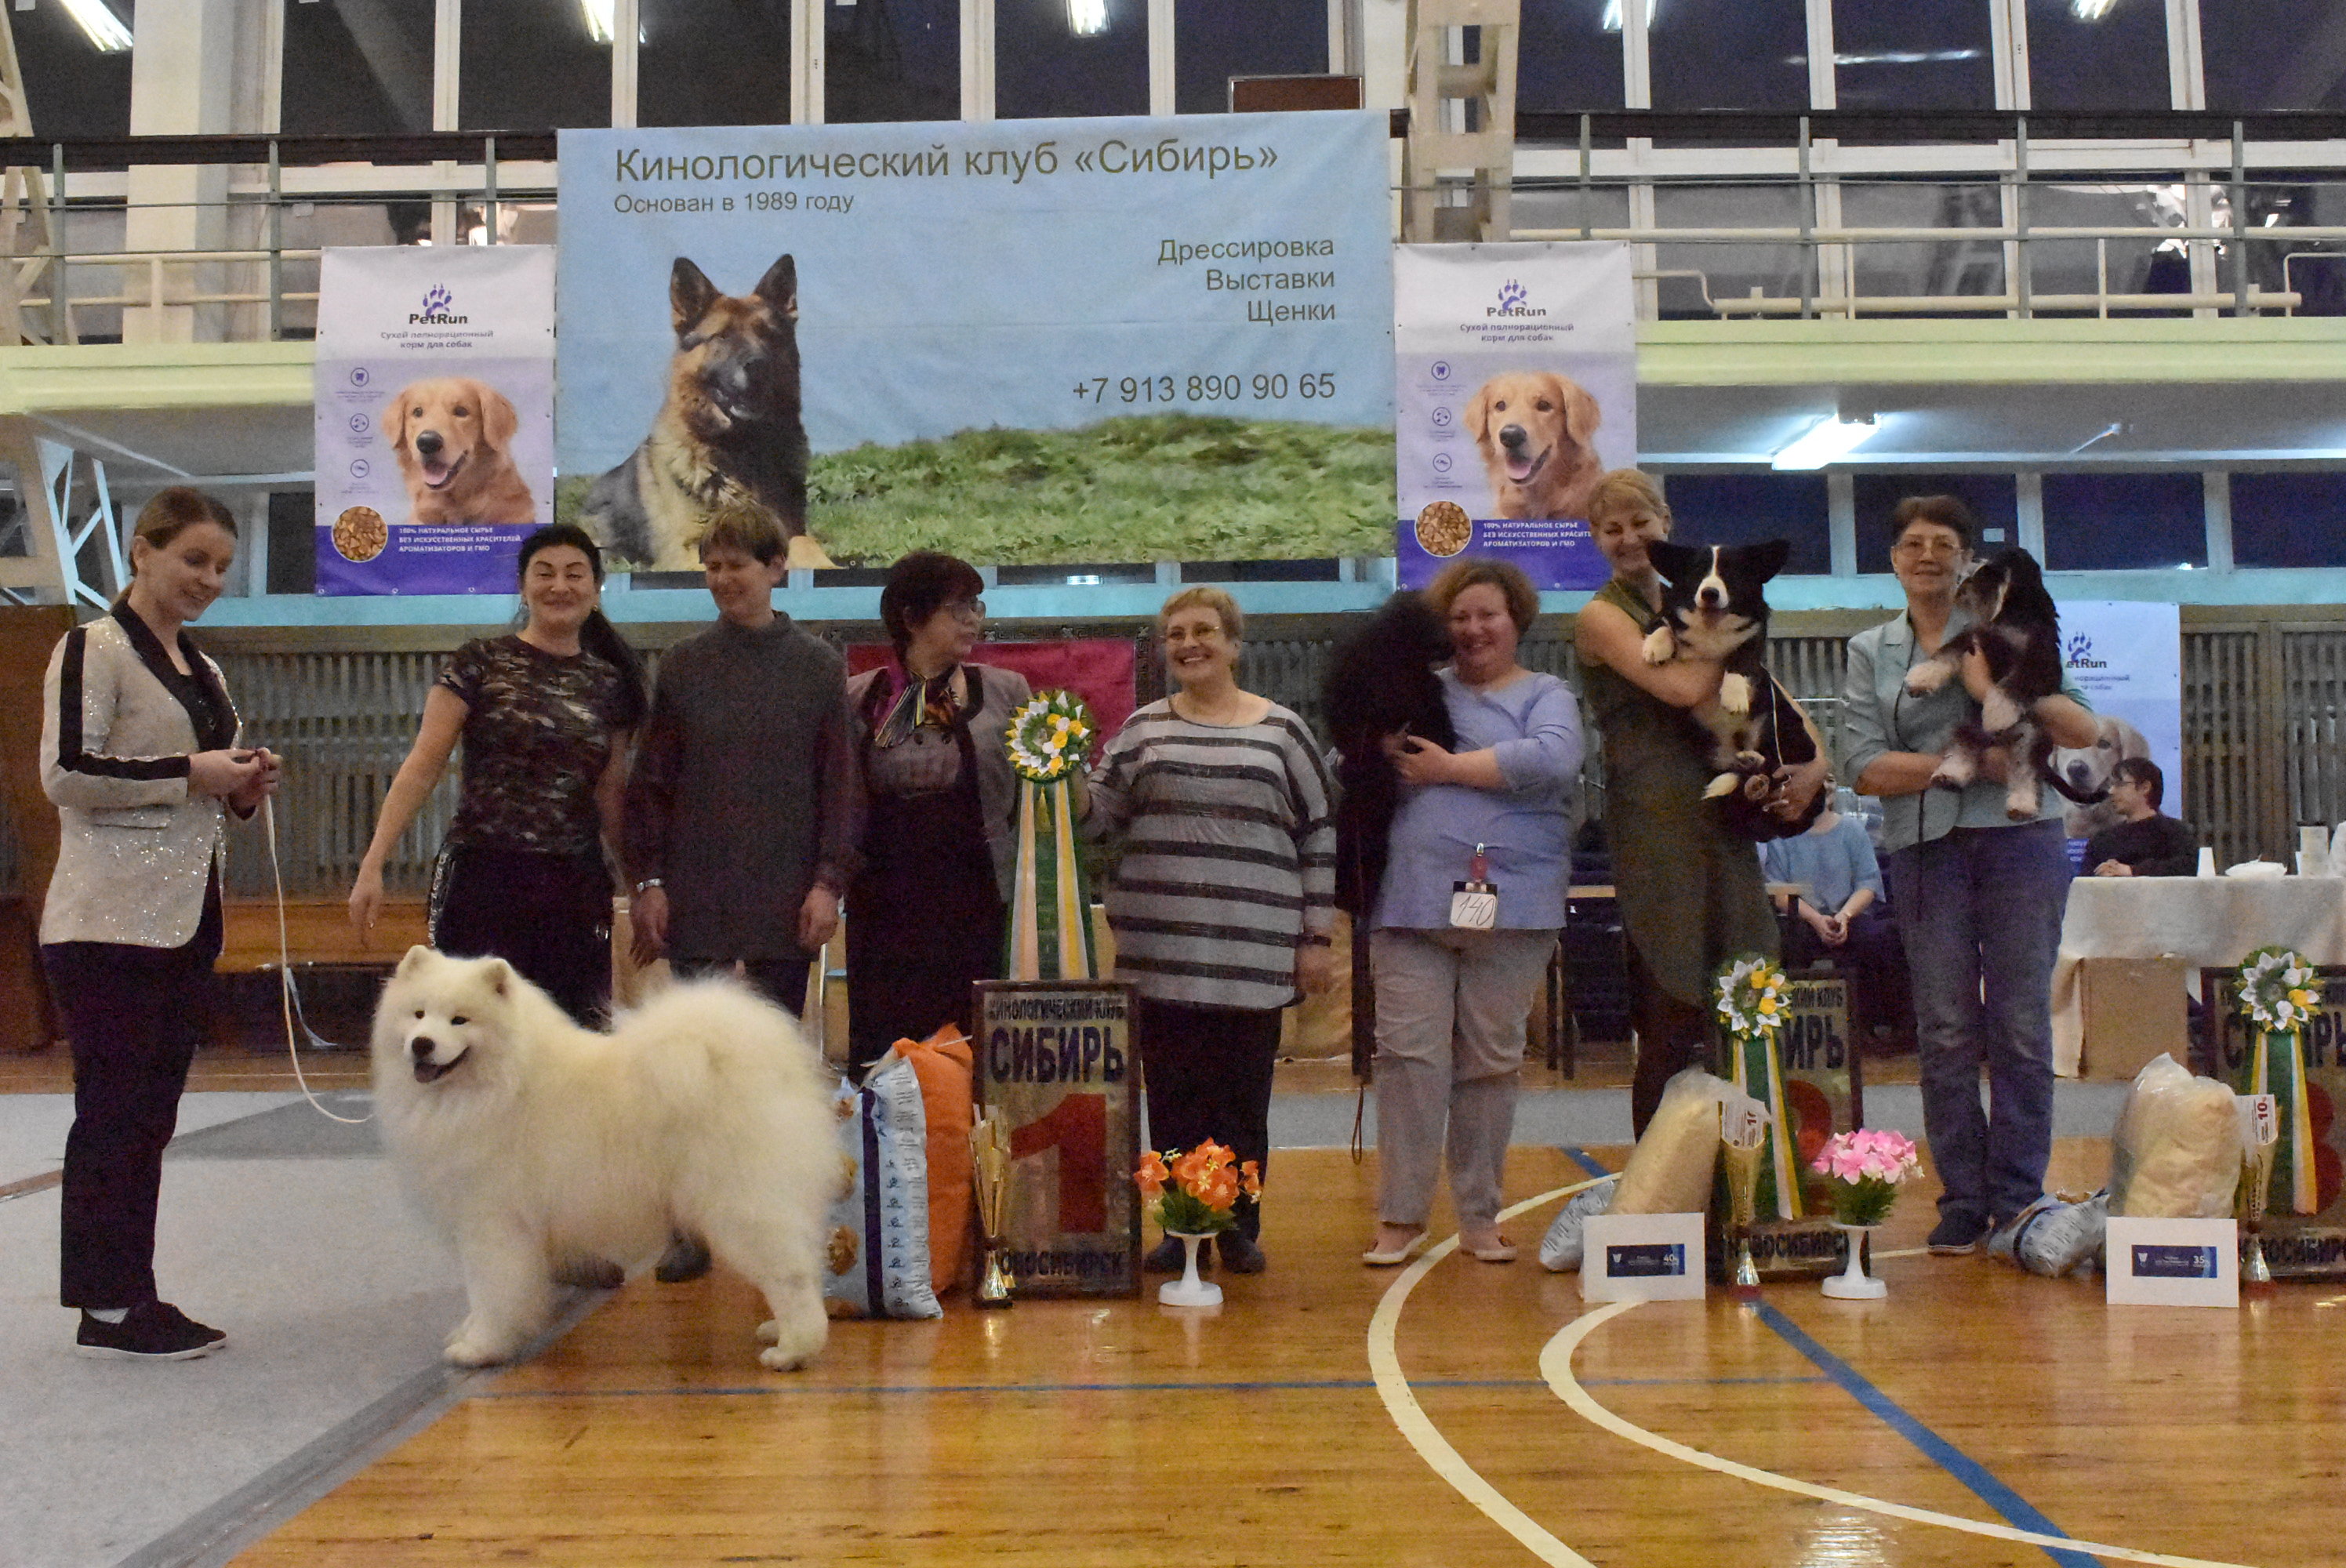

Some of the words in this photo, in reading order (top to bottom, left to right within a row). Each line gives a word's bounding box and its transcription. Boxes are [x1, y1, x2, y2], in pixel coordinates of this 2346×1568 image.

[616, 143, 950, 182] Кинологический
[965, 140, 1059, 184] клуб
[1074, 138, 1278, 180] «Сибирь»
[614, 194, 714, 213] Основан
[722, 197, 735, 212] в
[744, 191, 797, 212] 1989
[805, 194, 855, 213] году
[1157, 238, 1335, 266] Дрессировка
[1206, 269, 1335, 291] Выставки
[409, 314, 469, 325] PetRun
[1247, 299, 1335, 327] Щенки
[1487, 307, 1547, 318] PetRun
[381, 331, 409, 341] Сухой
[1460, 324, 1488, 333] Сухой
[1491, 323, 1574, 332] полнорационный
[1527, 333, 1554, 342] собак
[446, 340, 473, 349] собак
[1073, 377, 1109, 403] +7
[1120, 376, 1175, 402] 913
[1186, 374, 1241, 401] 890
[1252, 374, 1288, 400] 90
[1299, 372, 1336, 399] 65
[2066, 659, 2108, 669] etRun
[1456, 895, 1495, 926] 140
[990, 1026, 1124, 1083] СИБИРЬ
[1010, 1093, 1107, 1233] 1
